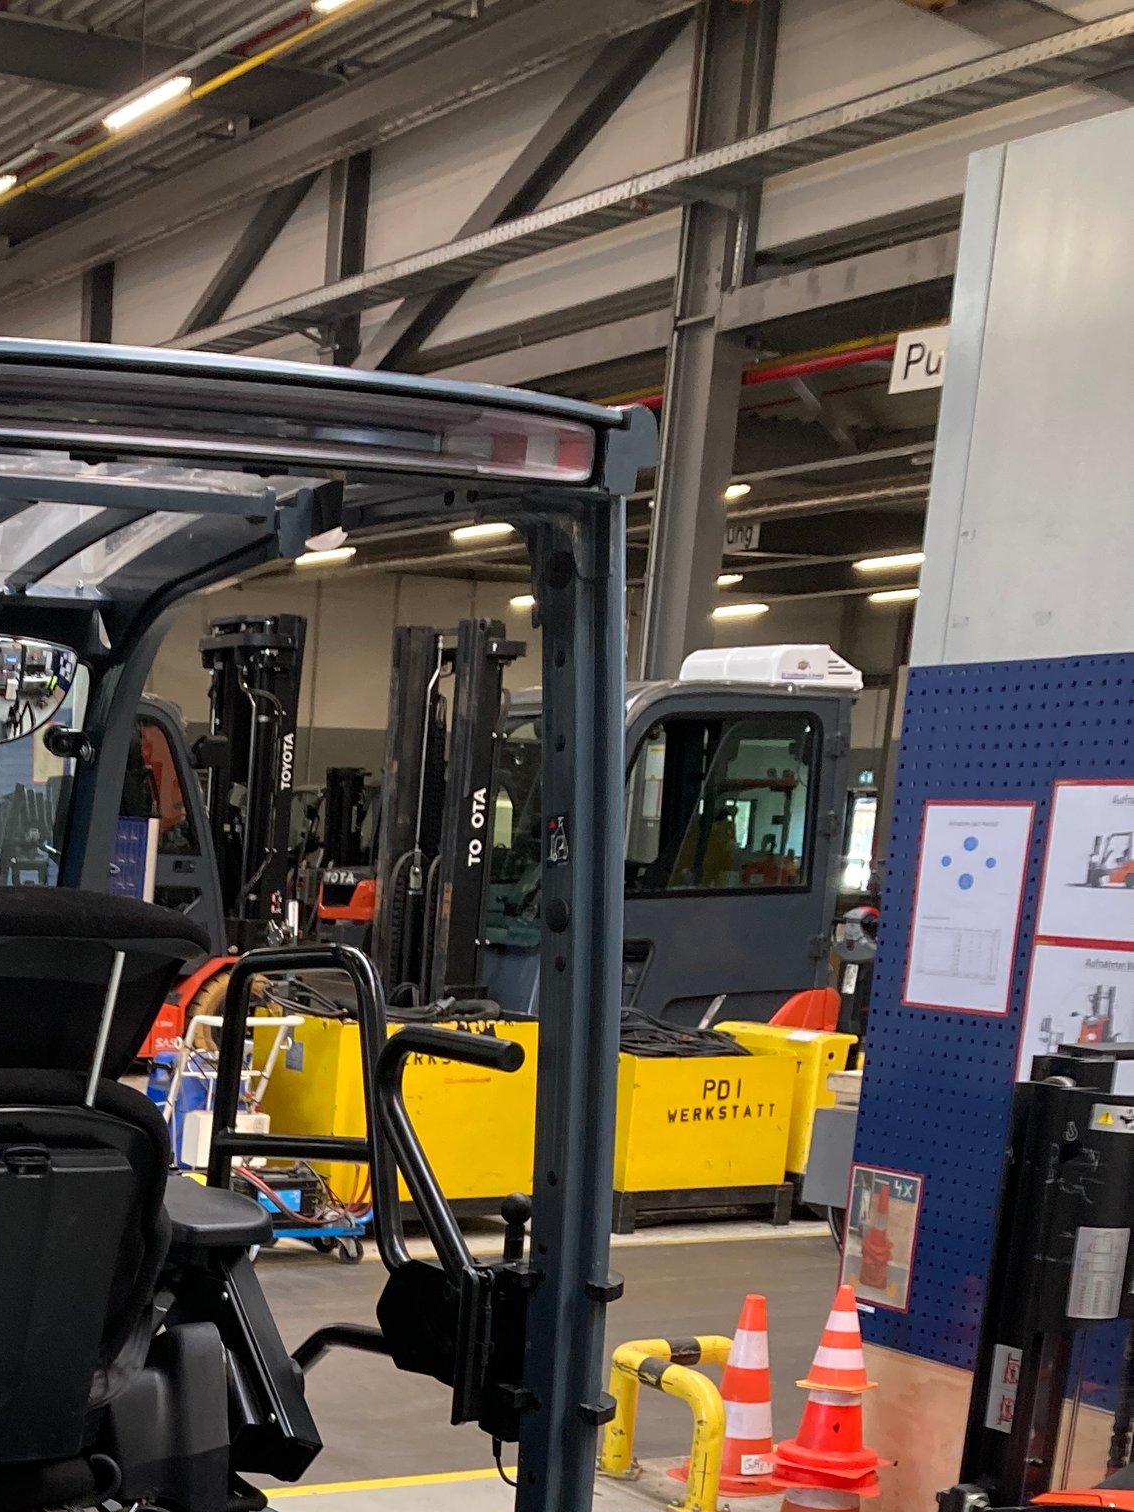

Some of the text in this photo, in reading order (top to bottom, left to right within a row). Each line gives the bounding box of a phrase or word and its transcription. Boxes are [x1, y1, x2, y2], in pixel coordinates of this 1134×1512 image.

[903, 342, 942, 380] Pu
[280, 732, 294, 790] TOYOTA
[702, 1078, 742, 1100] PDI
[667, 1103, 776, 1123] WERKSTATT
